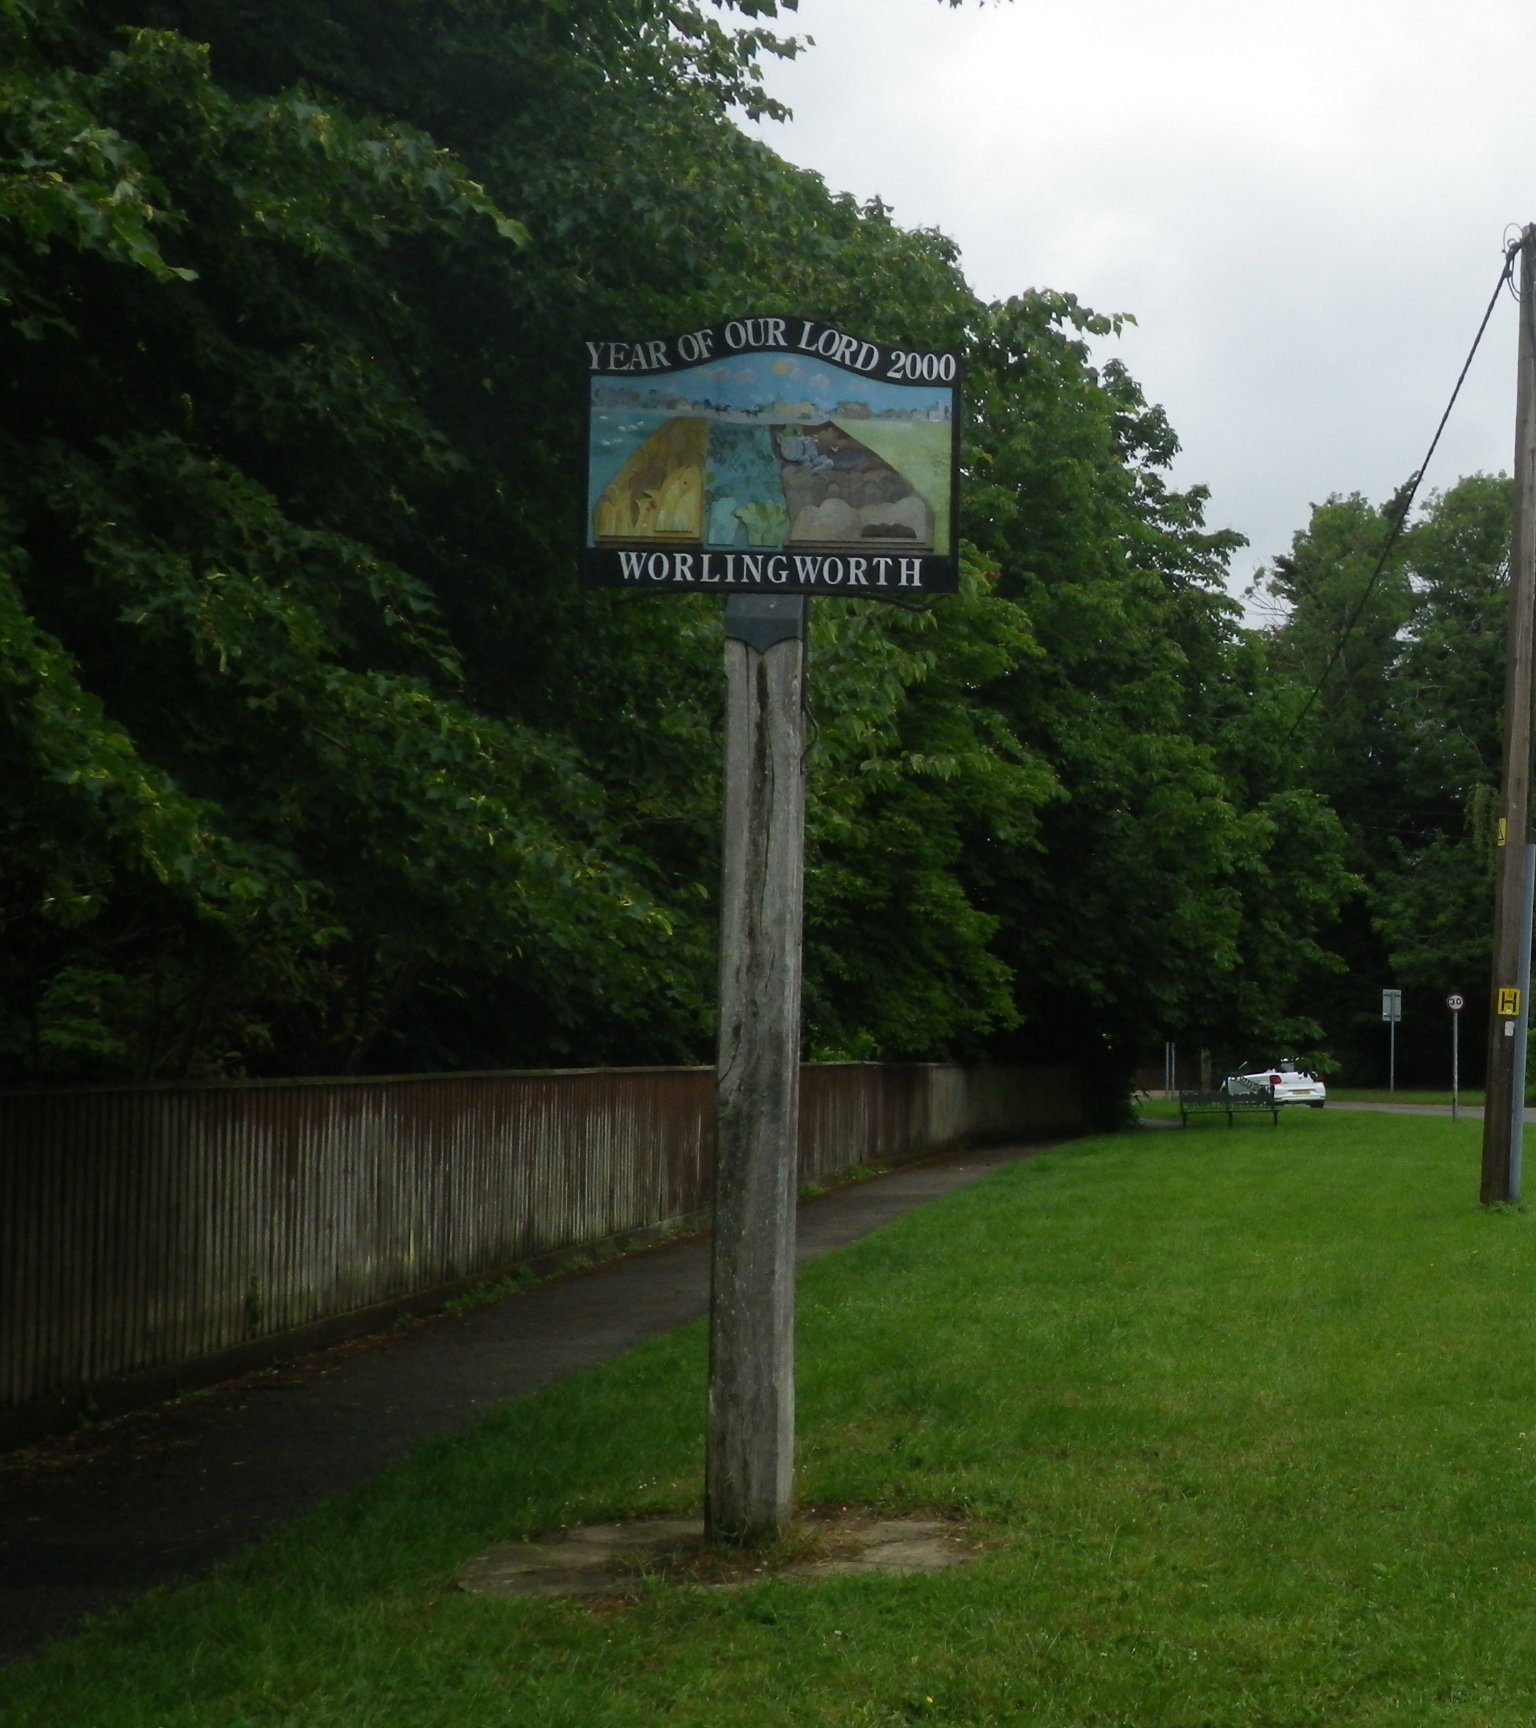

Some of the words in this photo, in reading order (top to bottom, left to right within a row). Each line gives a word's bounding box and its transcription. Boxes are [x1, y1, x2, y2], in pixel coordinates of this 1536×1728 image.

[586, 340, 670, 371] YEAR
[677, 328, 714, 363] OF
[724, 317, 788, 349] OUR
[798, 320, 879, 373] LORD
[886, 352, 956, 382] 2000
[618, 550, 923, 587] WORLINGWORTH
[1449, 998, 1462, 1006] 30
[1501, 991, 1517, 1013] H
